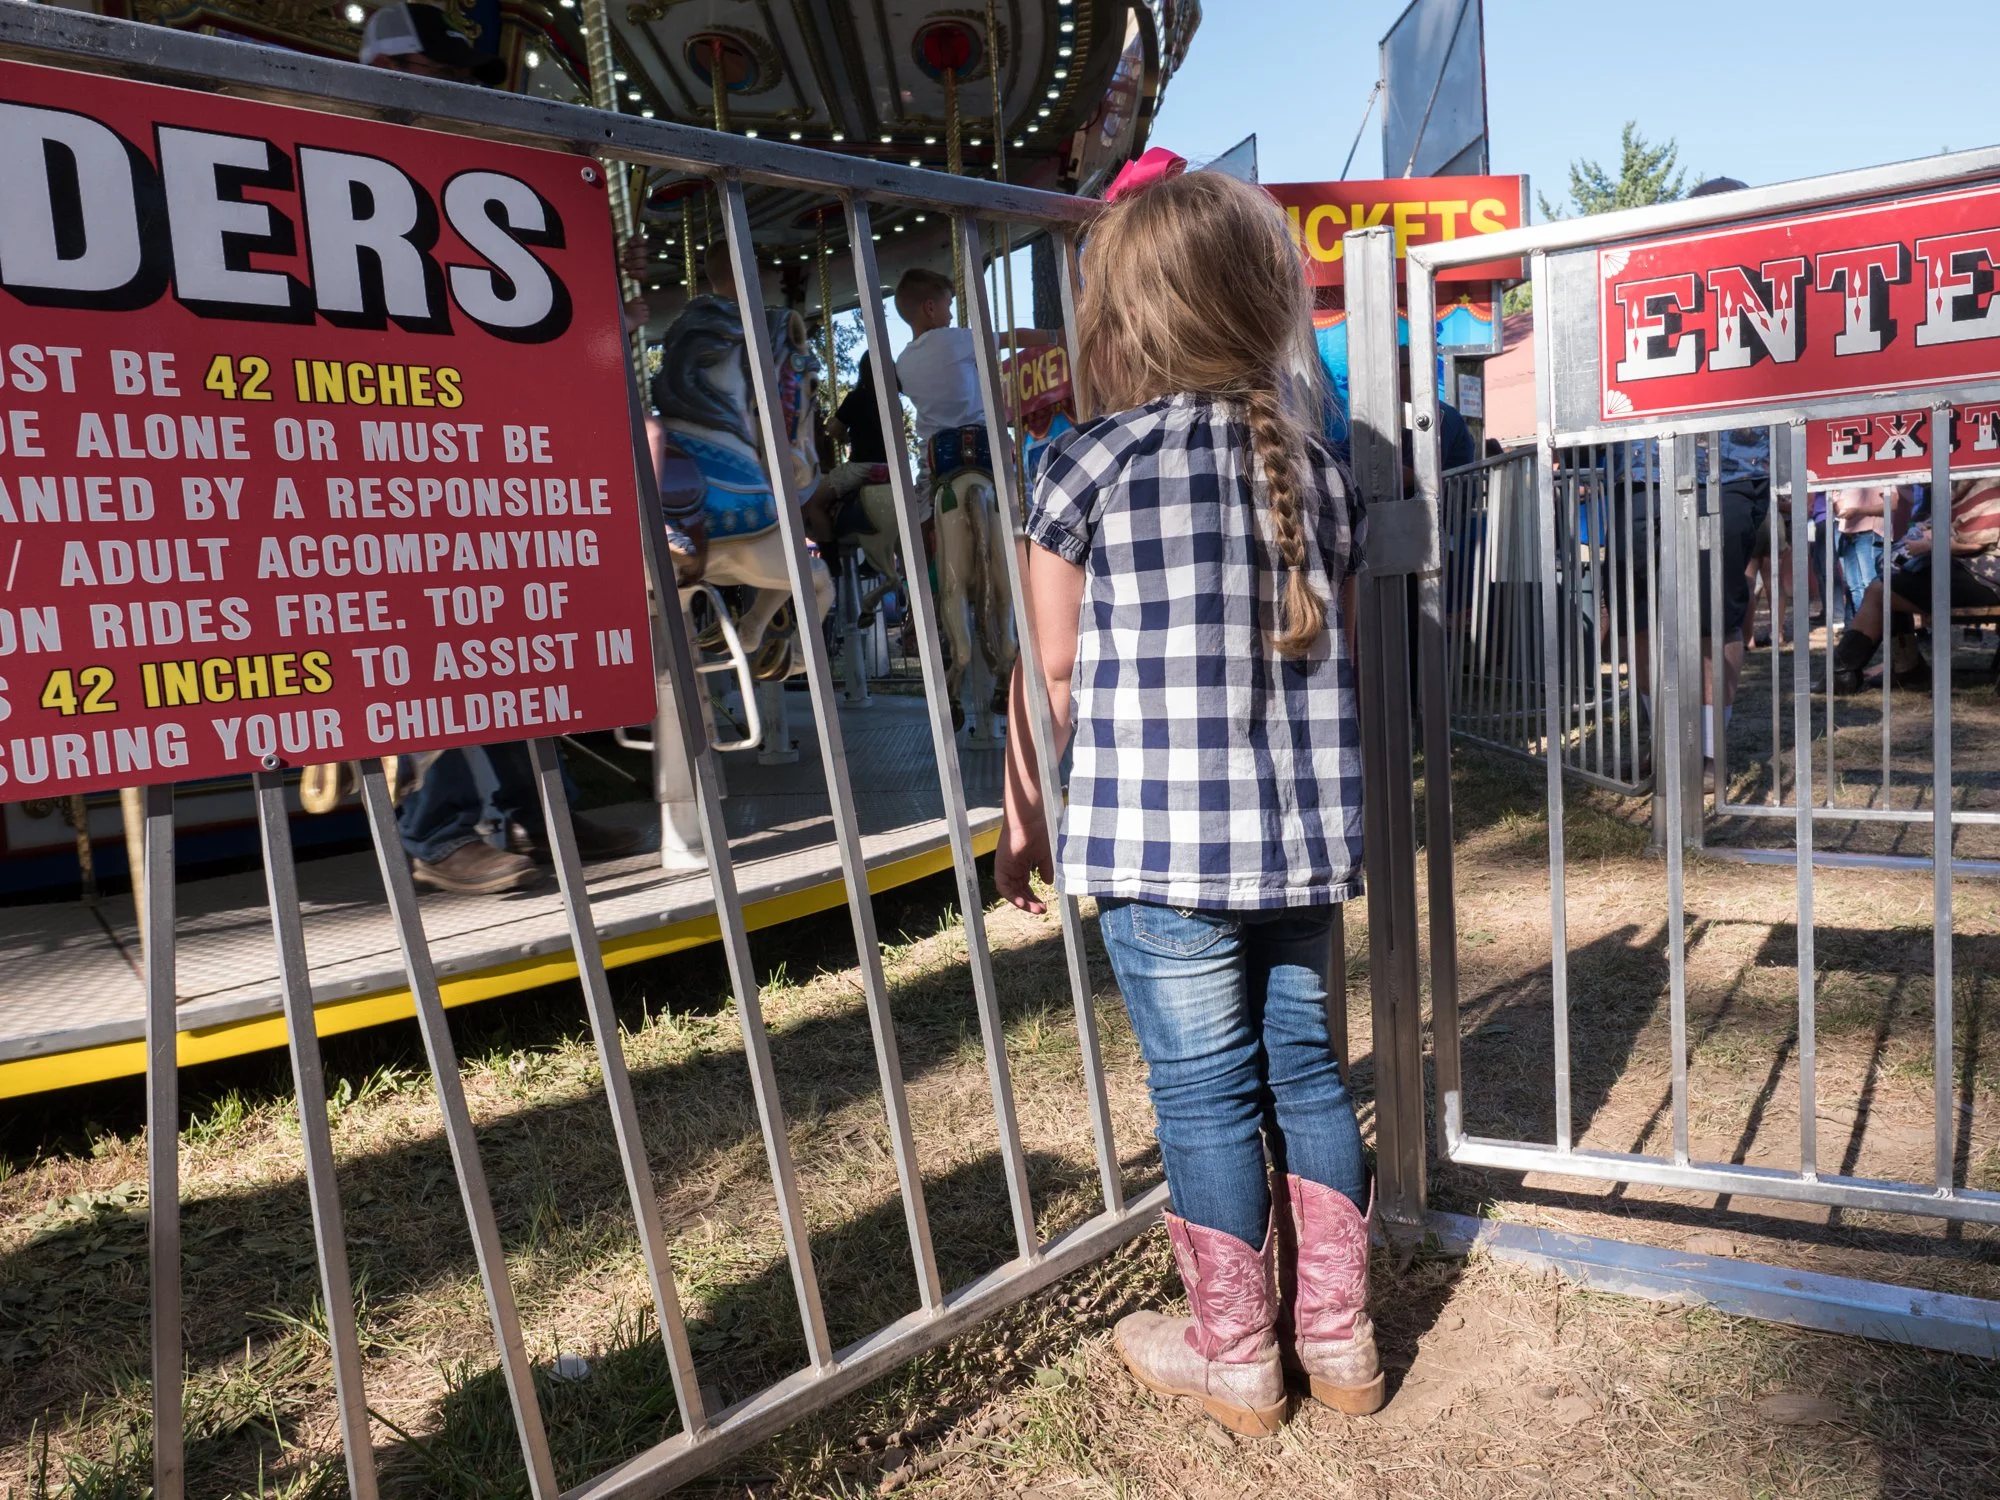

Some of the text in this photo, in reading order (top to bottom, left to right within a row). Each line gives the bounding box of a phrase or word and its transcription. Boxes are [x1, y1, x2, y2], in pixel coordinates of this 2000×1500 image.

[0, 343, 464, 409] ST BE 42 INCHES
[76, 412, 251, 461] ALONE
[273, 417, 338, 461] OR
[360, 420, 484, 463] MUST
[502, 424, 553, 464] BE
[1826, 404, 2000, 466] EXT
[181, 477, 245, 521] BY
[273, 477, 305, 520] A
[326, 477, 612, 519] RESPONSIBLE
[60, 537, 230, 588] ADULT
[257, 528, 600, 580] ACCOMPANYING
[89, 596, 252, 650] RIDES
[275, 590, 406, 638] FREE.
[423, 585, 505, 628] TOP
[523, 581, 569, 621] OF
[40, 665, 119, 717] 42
[140, 650, 334, 709] INCHES
[351, 644, 411, 689] TO
[433, 632, 579, 682] ASSIST
[595, 628, 634, 667] IN
[211, 708, 345, 762] YOUR
[365, 684, 583, 744] CHILDREN.
